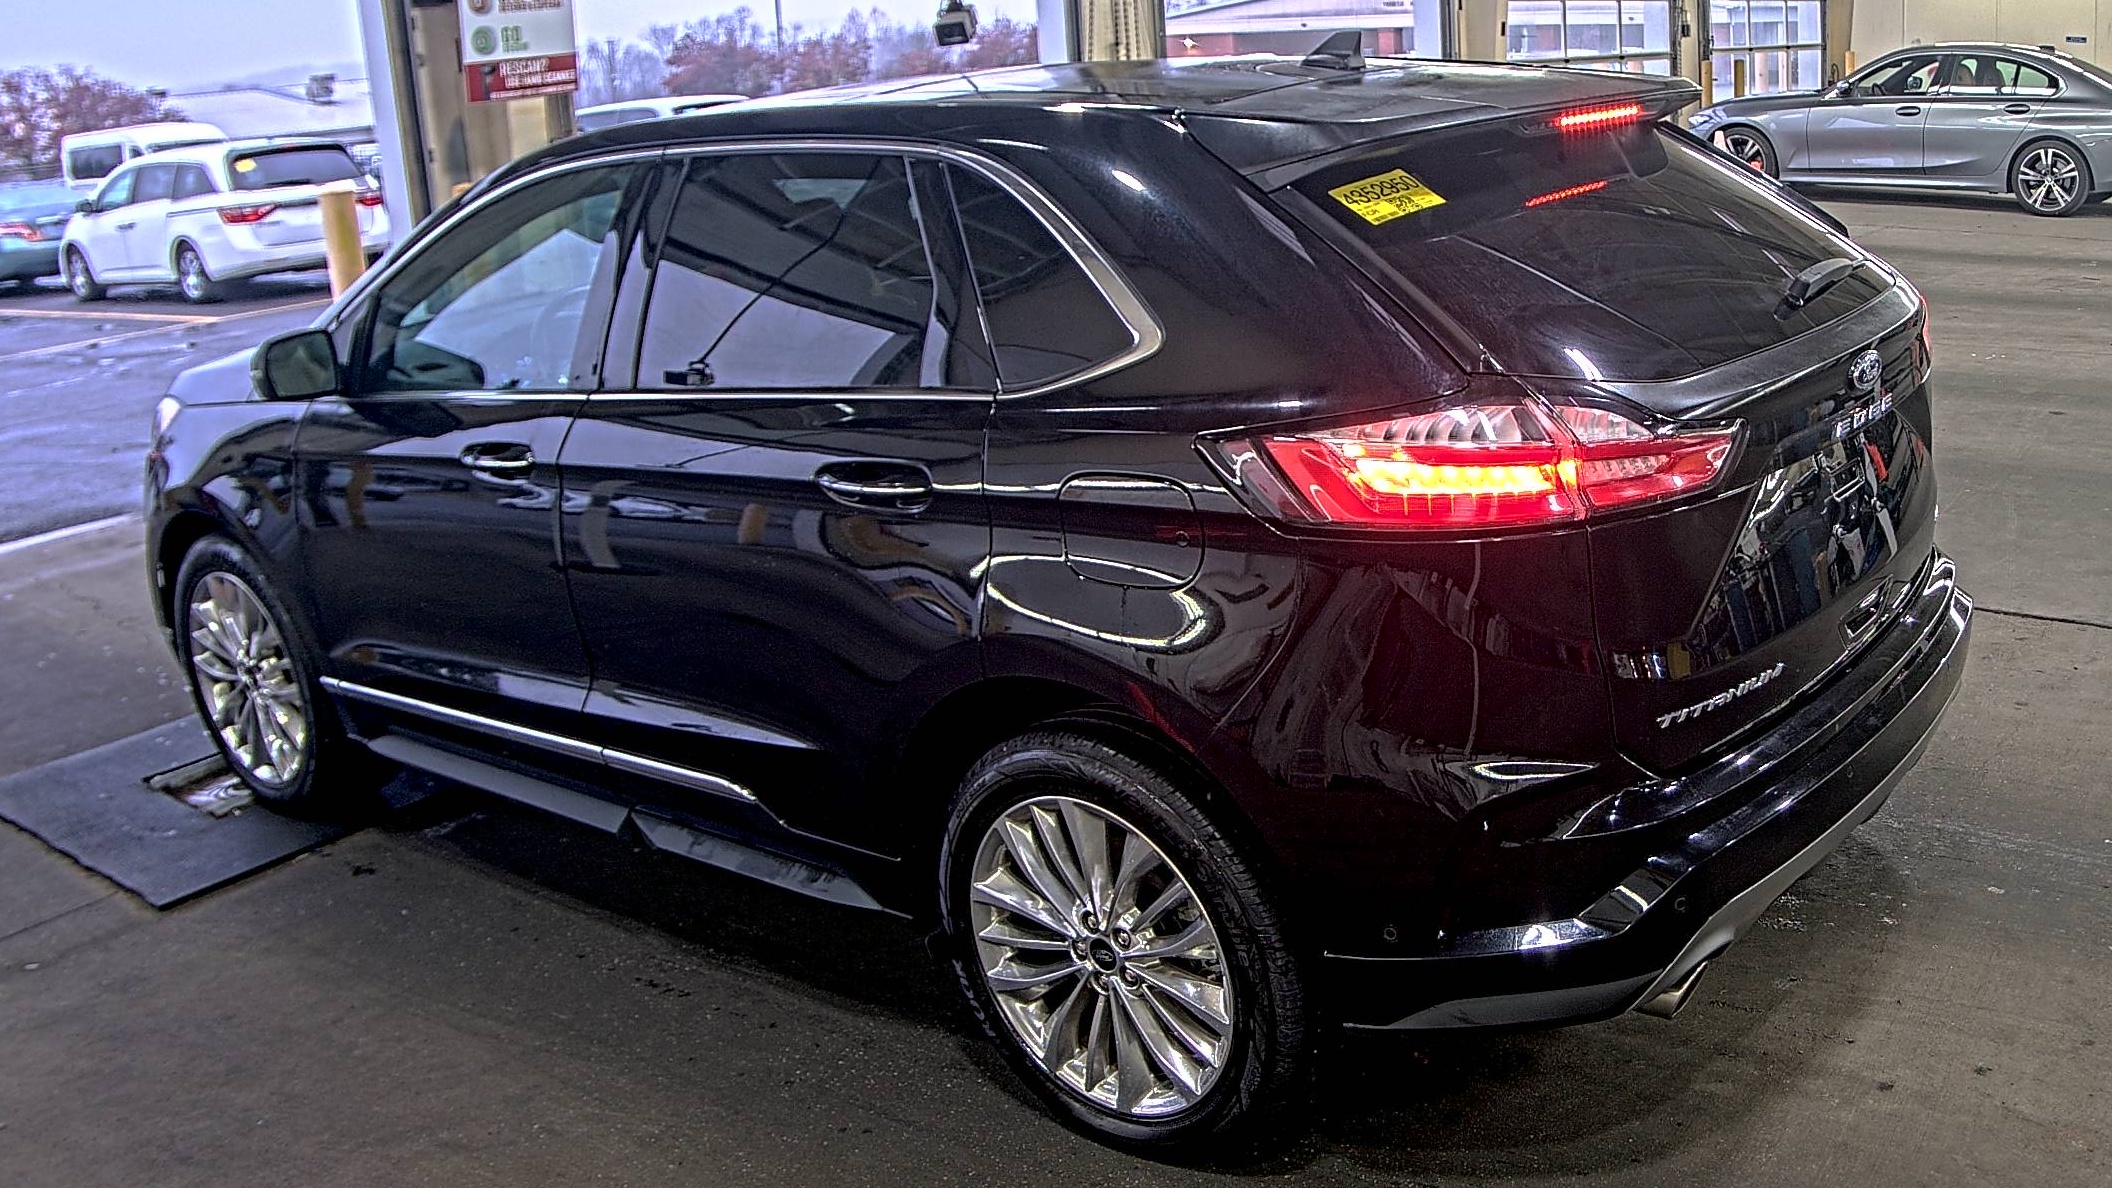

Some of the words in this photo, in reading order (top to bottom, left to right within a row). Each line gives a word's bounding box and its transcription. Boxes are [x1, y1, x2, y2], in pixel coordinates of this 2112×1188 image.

[499, 58, 549, 78] RESCAN?
[1342, 175, 1420, 206] 4352950
[1833, 392, 1894, 439] EDGE
[1655, 661, 1788, 729] TITANIUM
